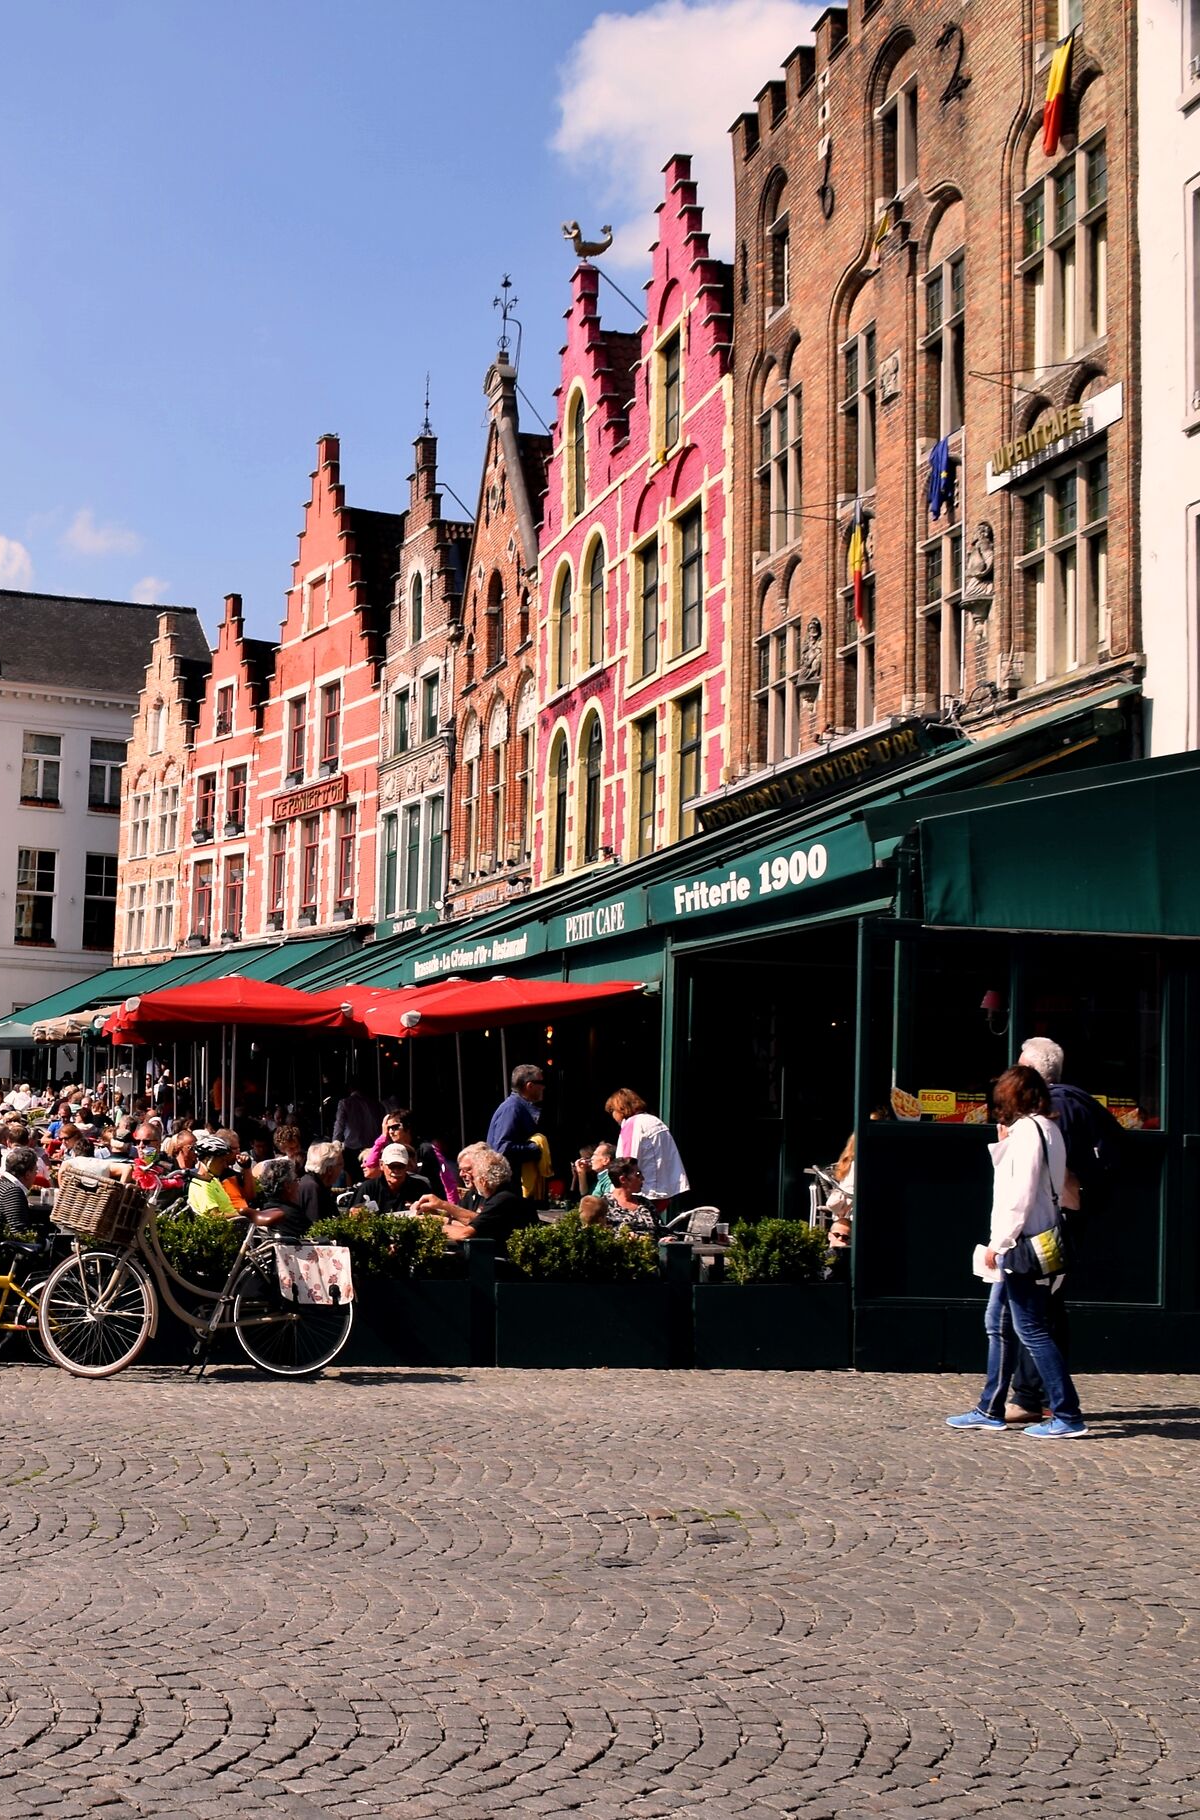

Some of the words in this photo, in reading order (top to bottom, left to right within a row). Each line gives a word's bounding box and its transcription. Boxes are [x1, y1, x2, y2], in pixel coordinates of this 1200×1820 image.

[1005, 425, 1043, 467] PETIT
[1043, 402, 1085, 446] CAFE
[702, 783, 781, 830] RESTAURANT
[784, 774, 808, 799] LA
[874, 729, 919, 763] D'OR
[288, 789, 320, 815] PANIER
[673, 871, 751, 915] Friterie
[758, 844, 828, 895] 1900
[565, 911, 595, 943] PETIT
[595, 901, 625, 935] CAFE
[442, 952, 451, 970] La
[491, 932, 528, 961] Restaurant
[921, 1094, 950, 1102] BELGO
